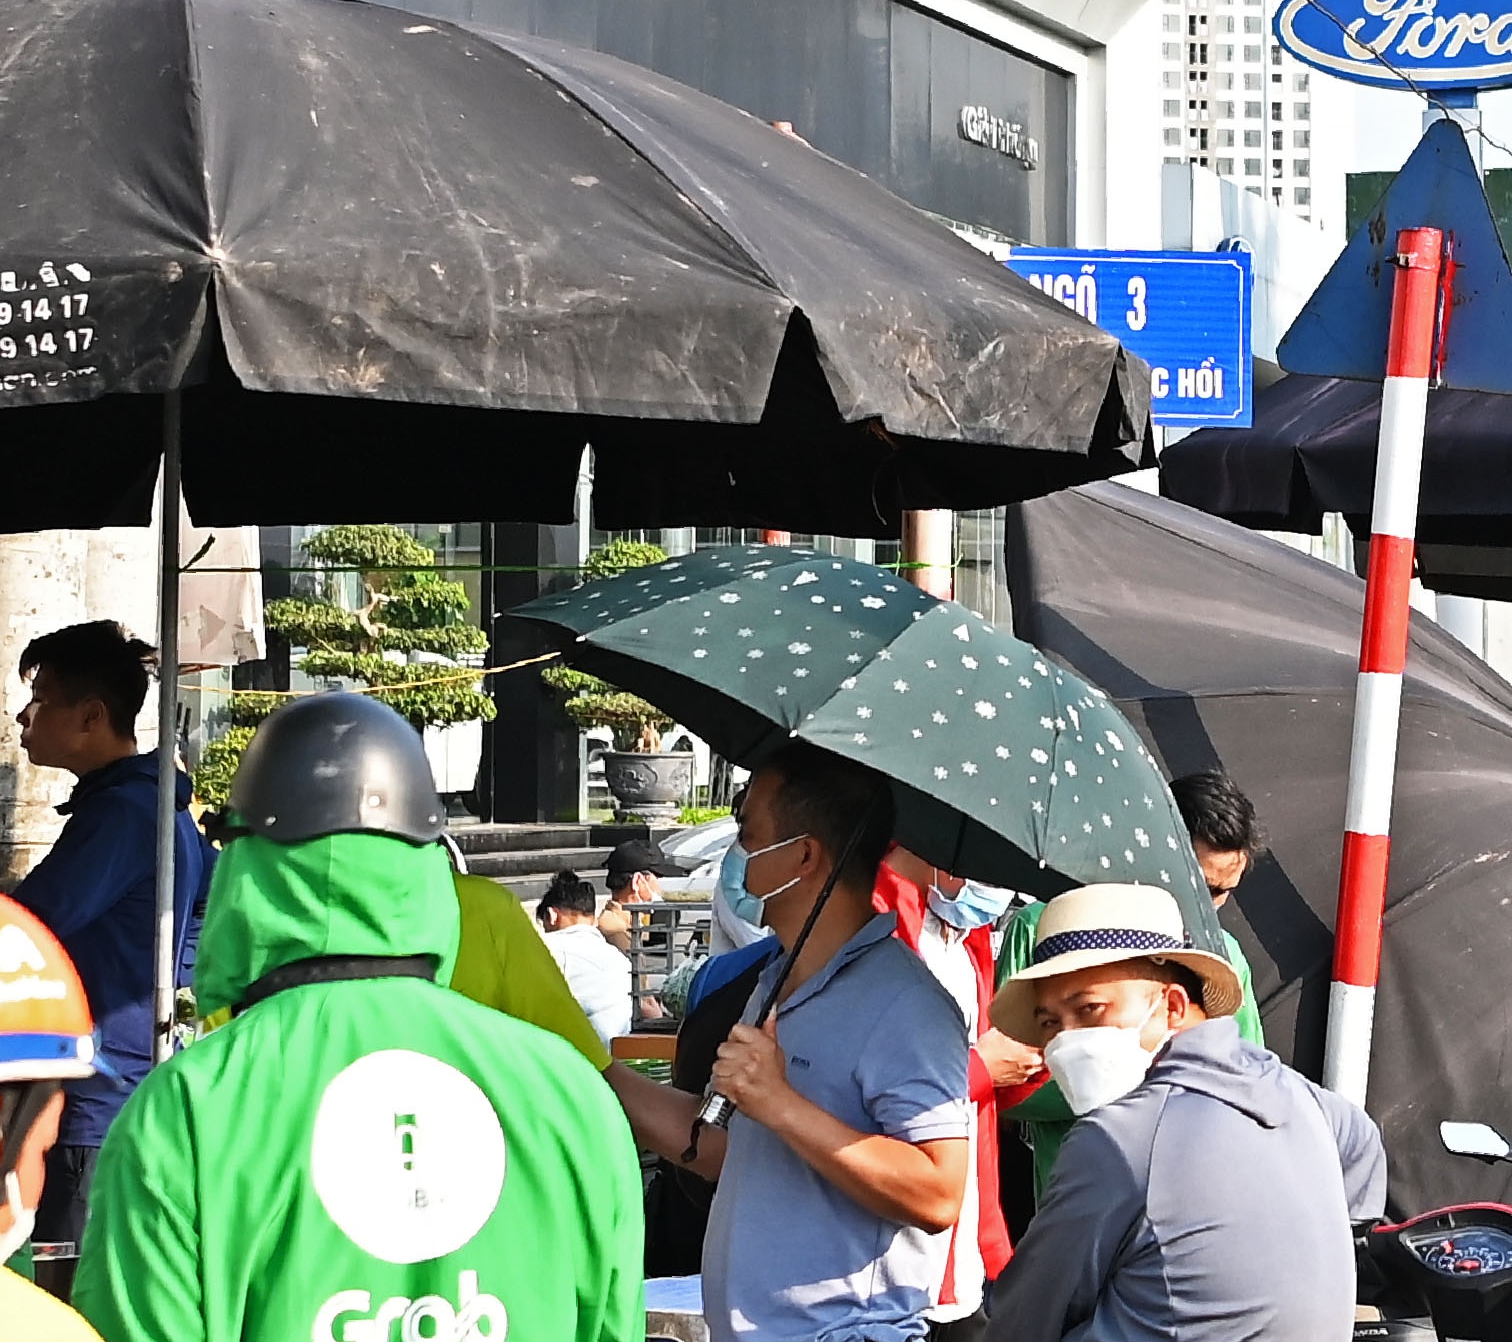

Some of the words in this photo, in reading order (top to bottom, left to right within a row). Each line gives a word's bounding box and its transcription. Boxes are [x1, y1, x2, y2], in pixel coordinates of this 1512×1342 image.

[21, 298, 53, 323] 14
[61, 294, 89, 319] 17
[1126, 276, 1148, 331] 3
[25, 332, 57, 356] 14
[64, 328, 93, 352] 17
[1177, 357, 1223, 399] HỒI
